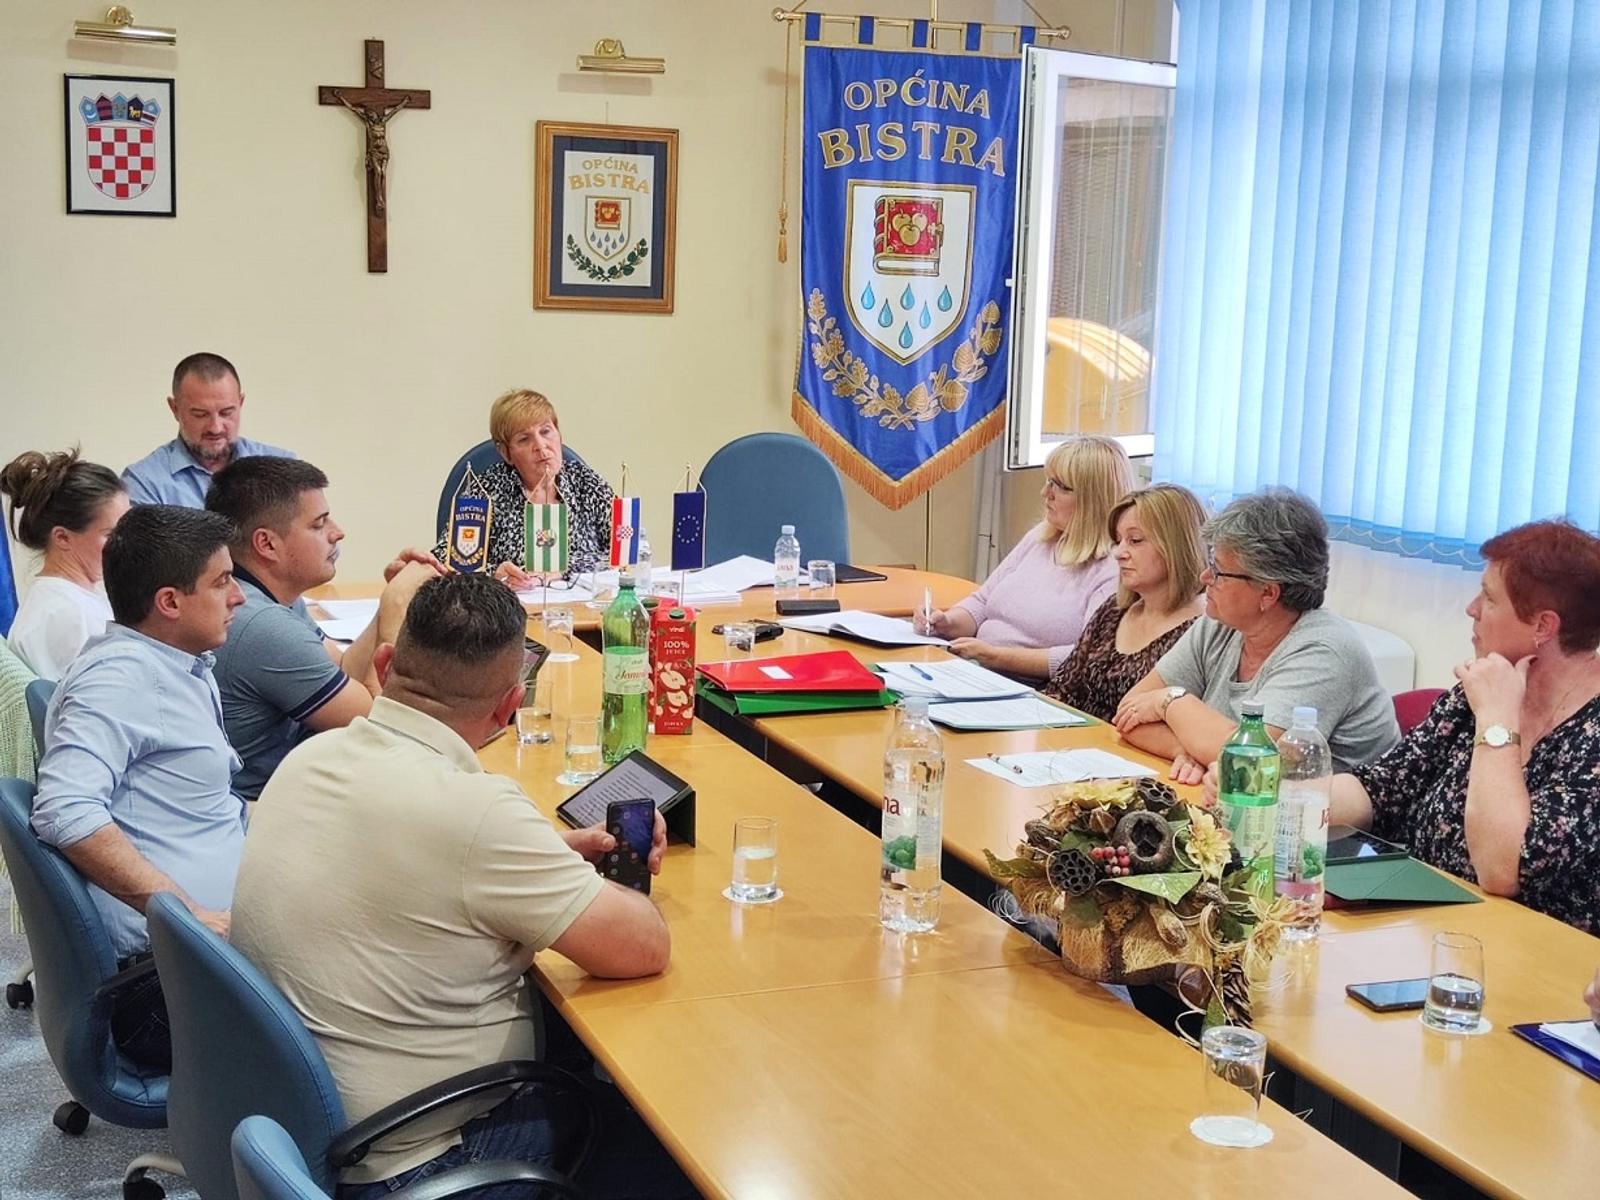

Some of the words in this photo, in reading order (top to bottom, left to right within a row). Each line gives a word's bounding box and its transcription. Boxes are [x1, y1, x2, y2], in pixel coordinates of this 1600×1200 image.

[844, 69, 990, 119] OPĆINA
[818, 122, 1005, 176] BISTRA
[582, 157, 638, 173] OPĆINA
[568, 173, 650, 194] BISTRA
[663, 640, 690, 649] 100%
